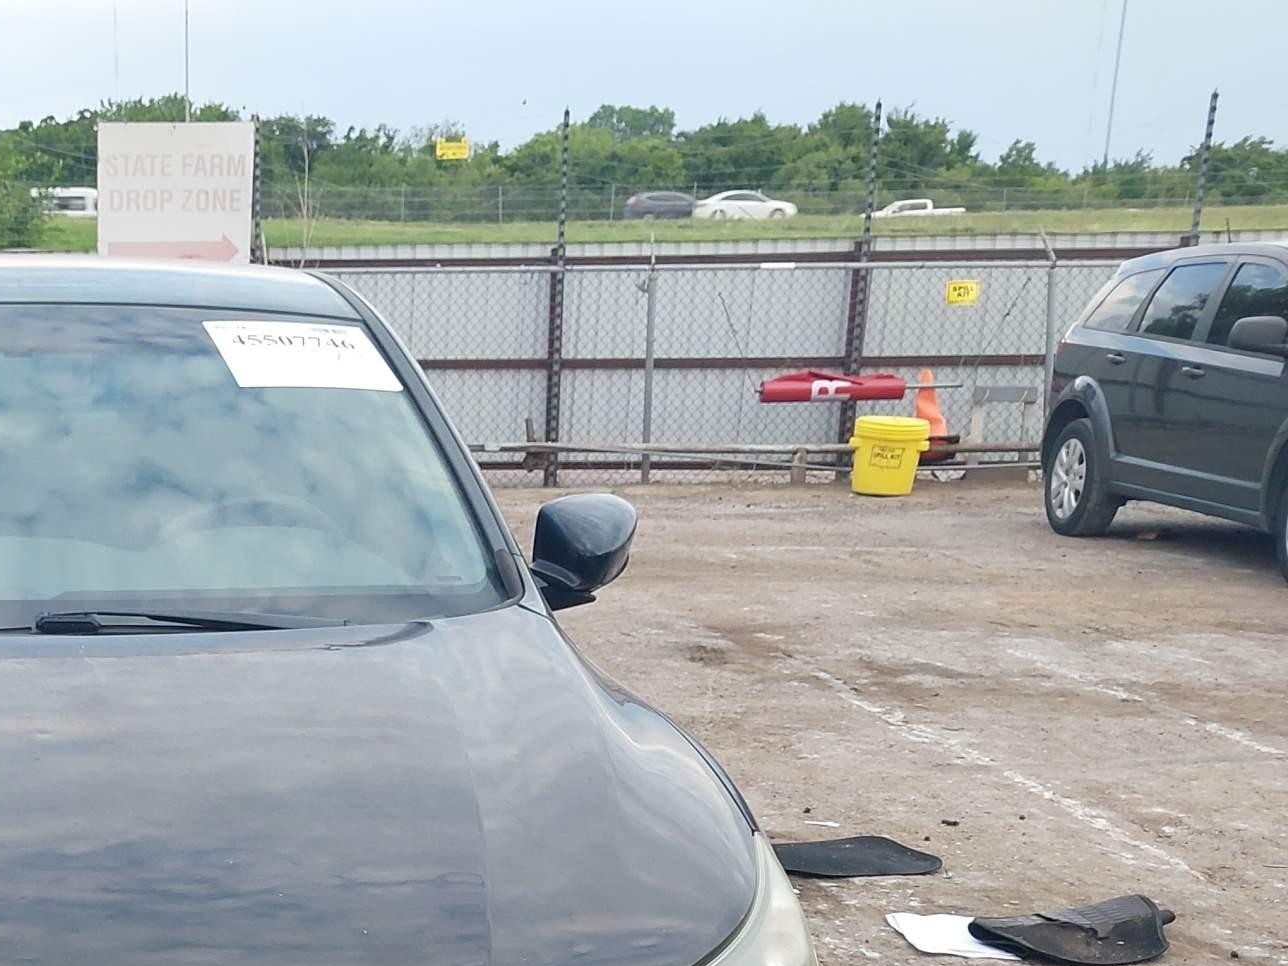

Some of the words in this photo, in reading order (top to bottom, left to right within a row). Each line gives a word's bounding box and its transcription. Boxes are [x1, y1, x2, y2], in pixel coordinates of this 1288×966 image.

[105, 153, 173, 177] STATE
[181, 153, 246, 177] FARM
[109, 188, 173, 212] DROP
[181, 188, 242, 212] ZONE
